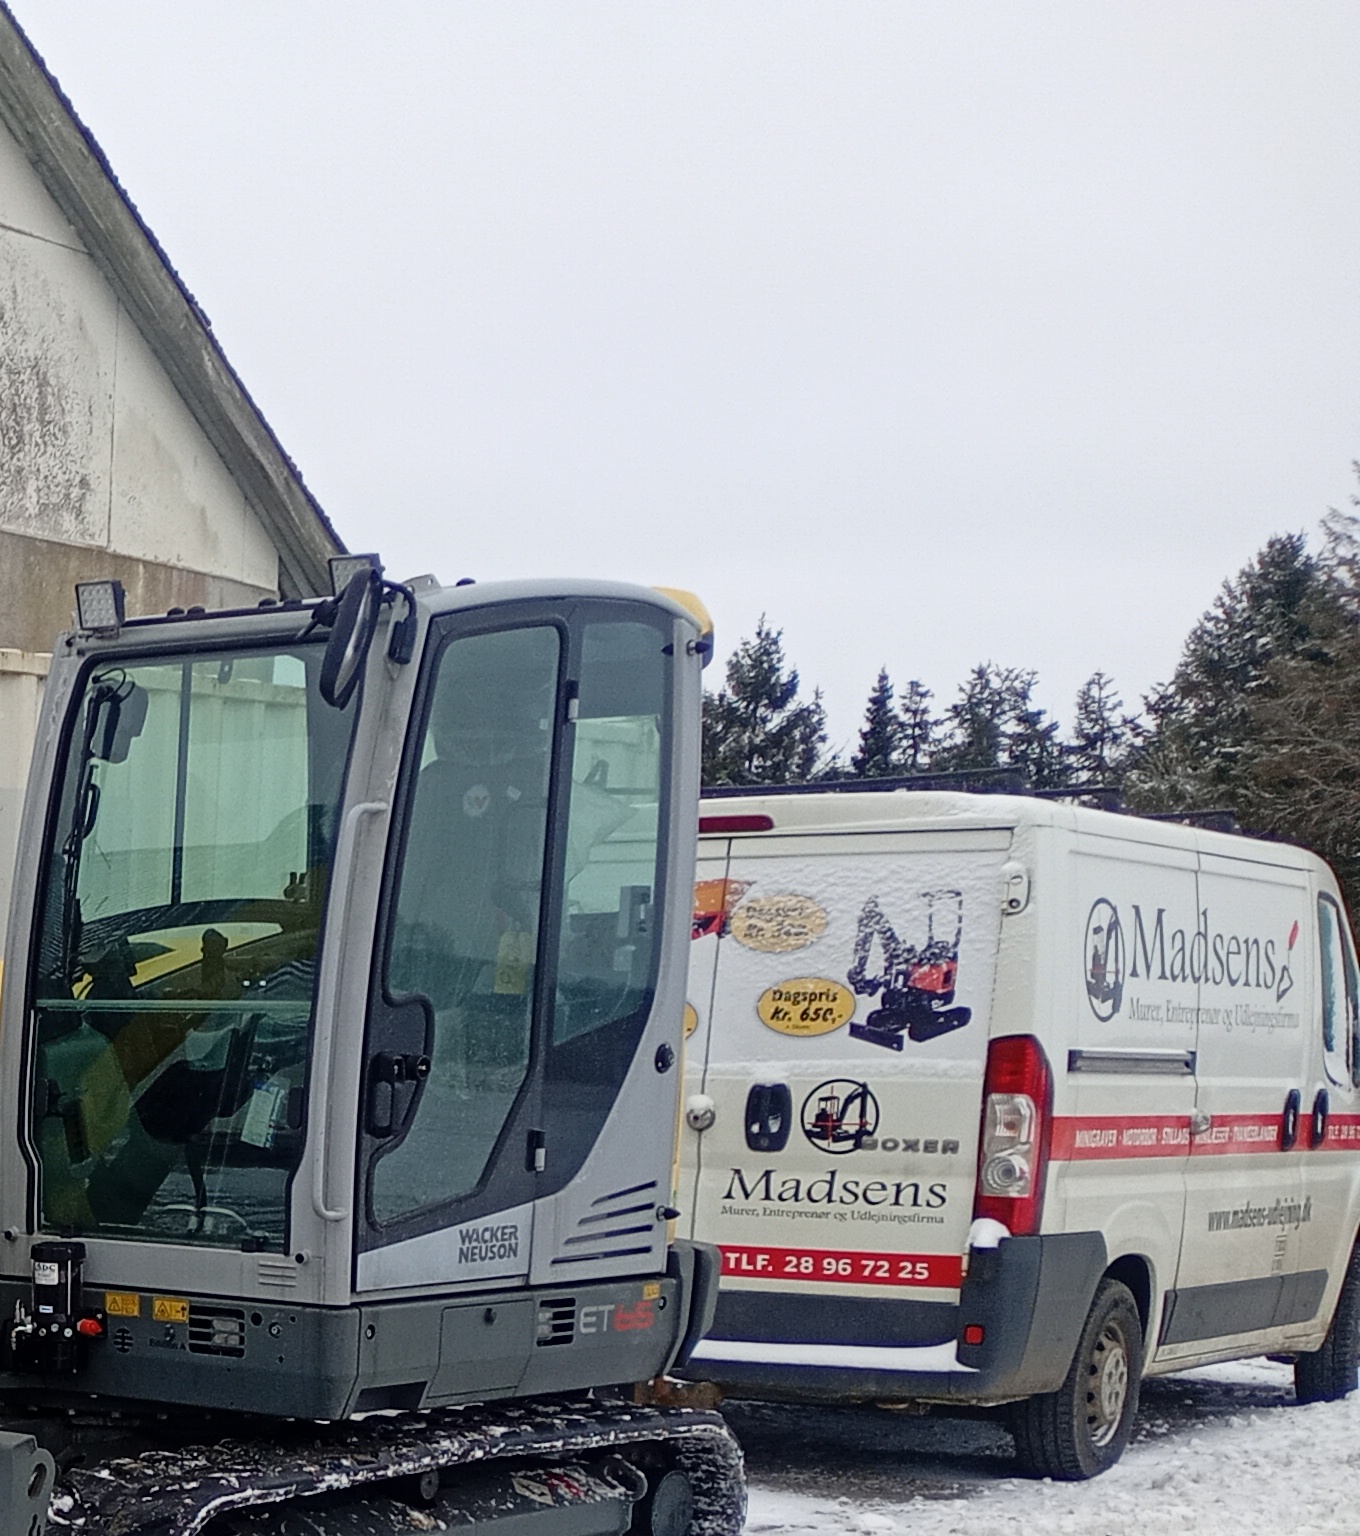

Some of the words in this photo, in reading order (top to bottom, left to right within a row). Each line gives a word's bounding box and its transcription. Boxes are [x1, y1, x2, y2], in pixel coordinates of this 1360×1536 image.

[1130, 904, 1276, 990] Madsens
[771, 988, 838, 1006] Dagspris
[770, 1006, 792, 1022] Kr.
[861, 1136, 960, 1154] BOXER
[722, 1168, 948, 1209] Madsens
[720, 1205, 760, 1218] Murer,
[833, 1211, 848, 1222] og
[458, 1224, 519, 1247] WACKER
[458, 1242, 518, 1264] NEUSON
[726, 1252, 773, 1272] TLF.
[783, 1255, 814, 1274] 28
[822, 1257, 852, 1276] 96
[860, 1259, 890, 1278] 72
[898, 1261, 930, 1280] 25
